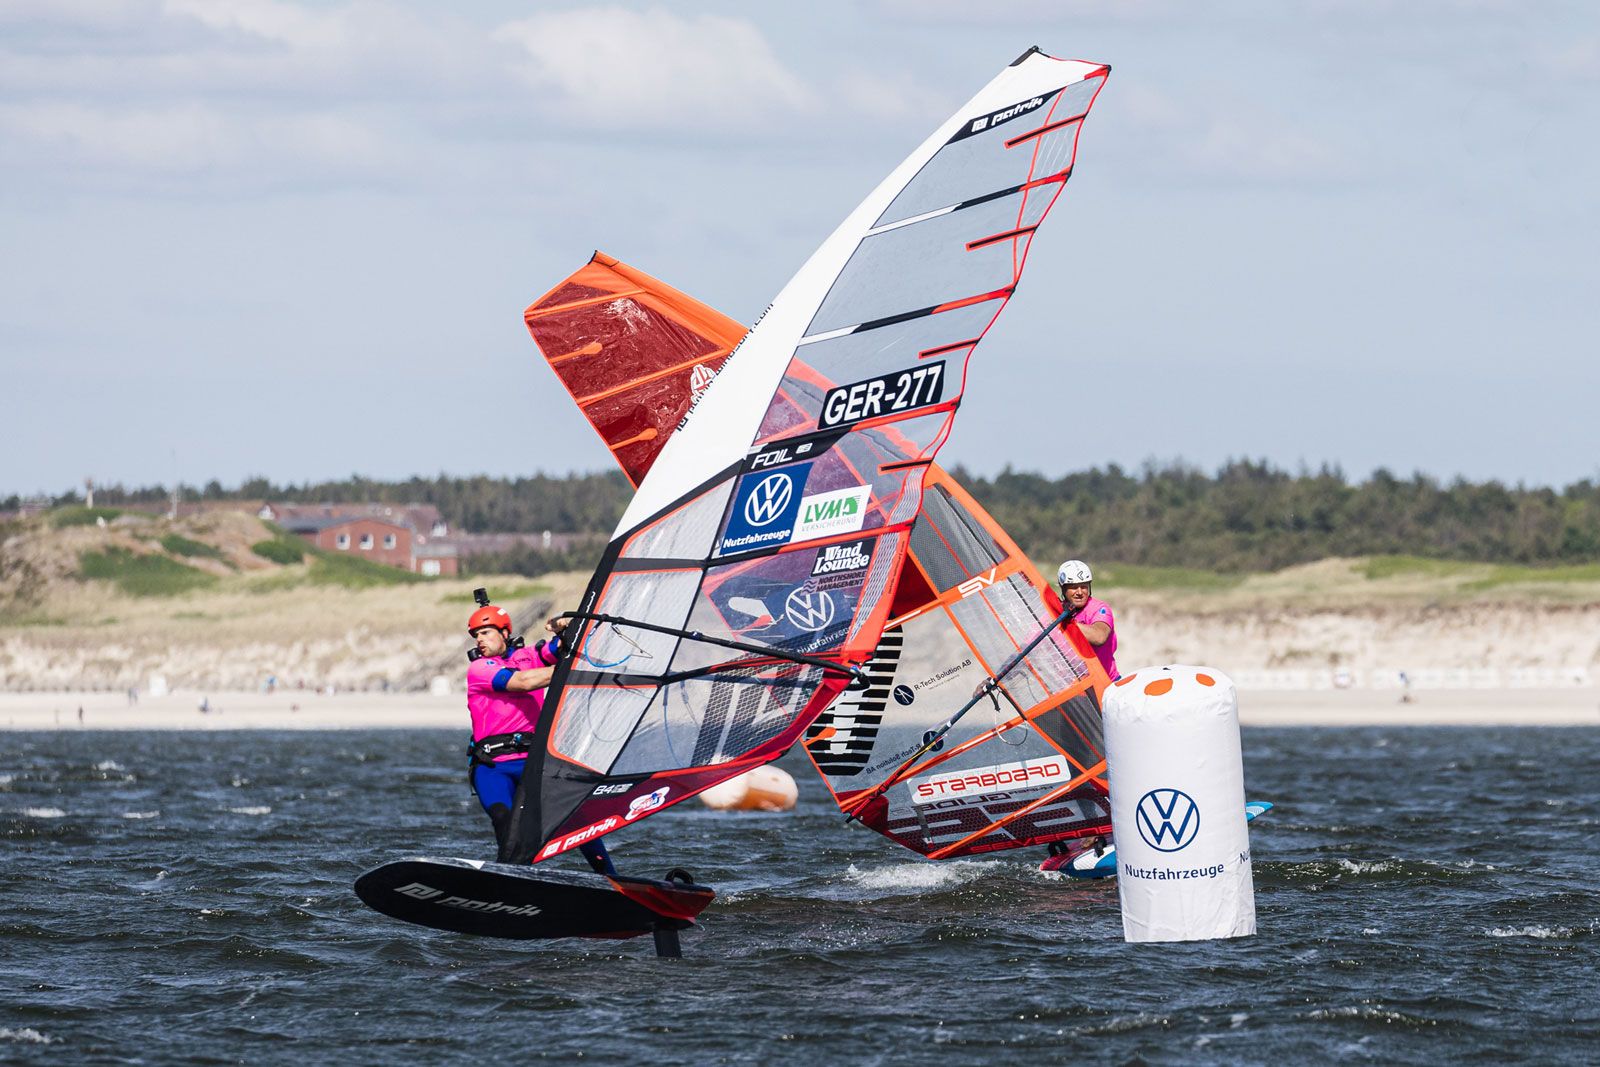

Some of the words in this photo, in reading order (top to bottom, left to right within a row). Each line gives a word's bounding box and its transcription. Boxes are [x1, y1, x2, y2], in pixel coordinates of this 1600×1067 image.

[991, 98, 1043, 126] patrik
[825, 365, 942, 425] GER-277
[751, 448, 792, 469] FOIL
[804, 499, 842, 523] LVM
[723, 529, 791, 548] Nutzfahrzeuge
[825, 542, 863, 561] Wind
[813, 554, 870, 574] Lounge
[816, 579, 864, 592] MANAGEMENT
[818, 570, 867, 584] NORTHSHORE
[914, 676, 936, 691] R-Tech
[935, 665, 962, 681] Solution
[961, 659, 972, 668] AB
[917, 763, 1061, 797] STARBOARD
[563, 818, 617, 850] patrik
[1125, 862, 1225, 880] Nutzfahrzeuge
[434, 896, 543, 916] patrik
